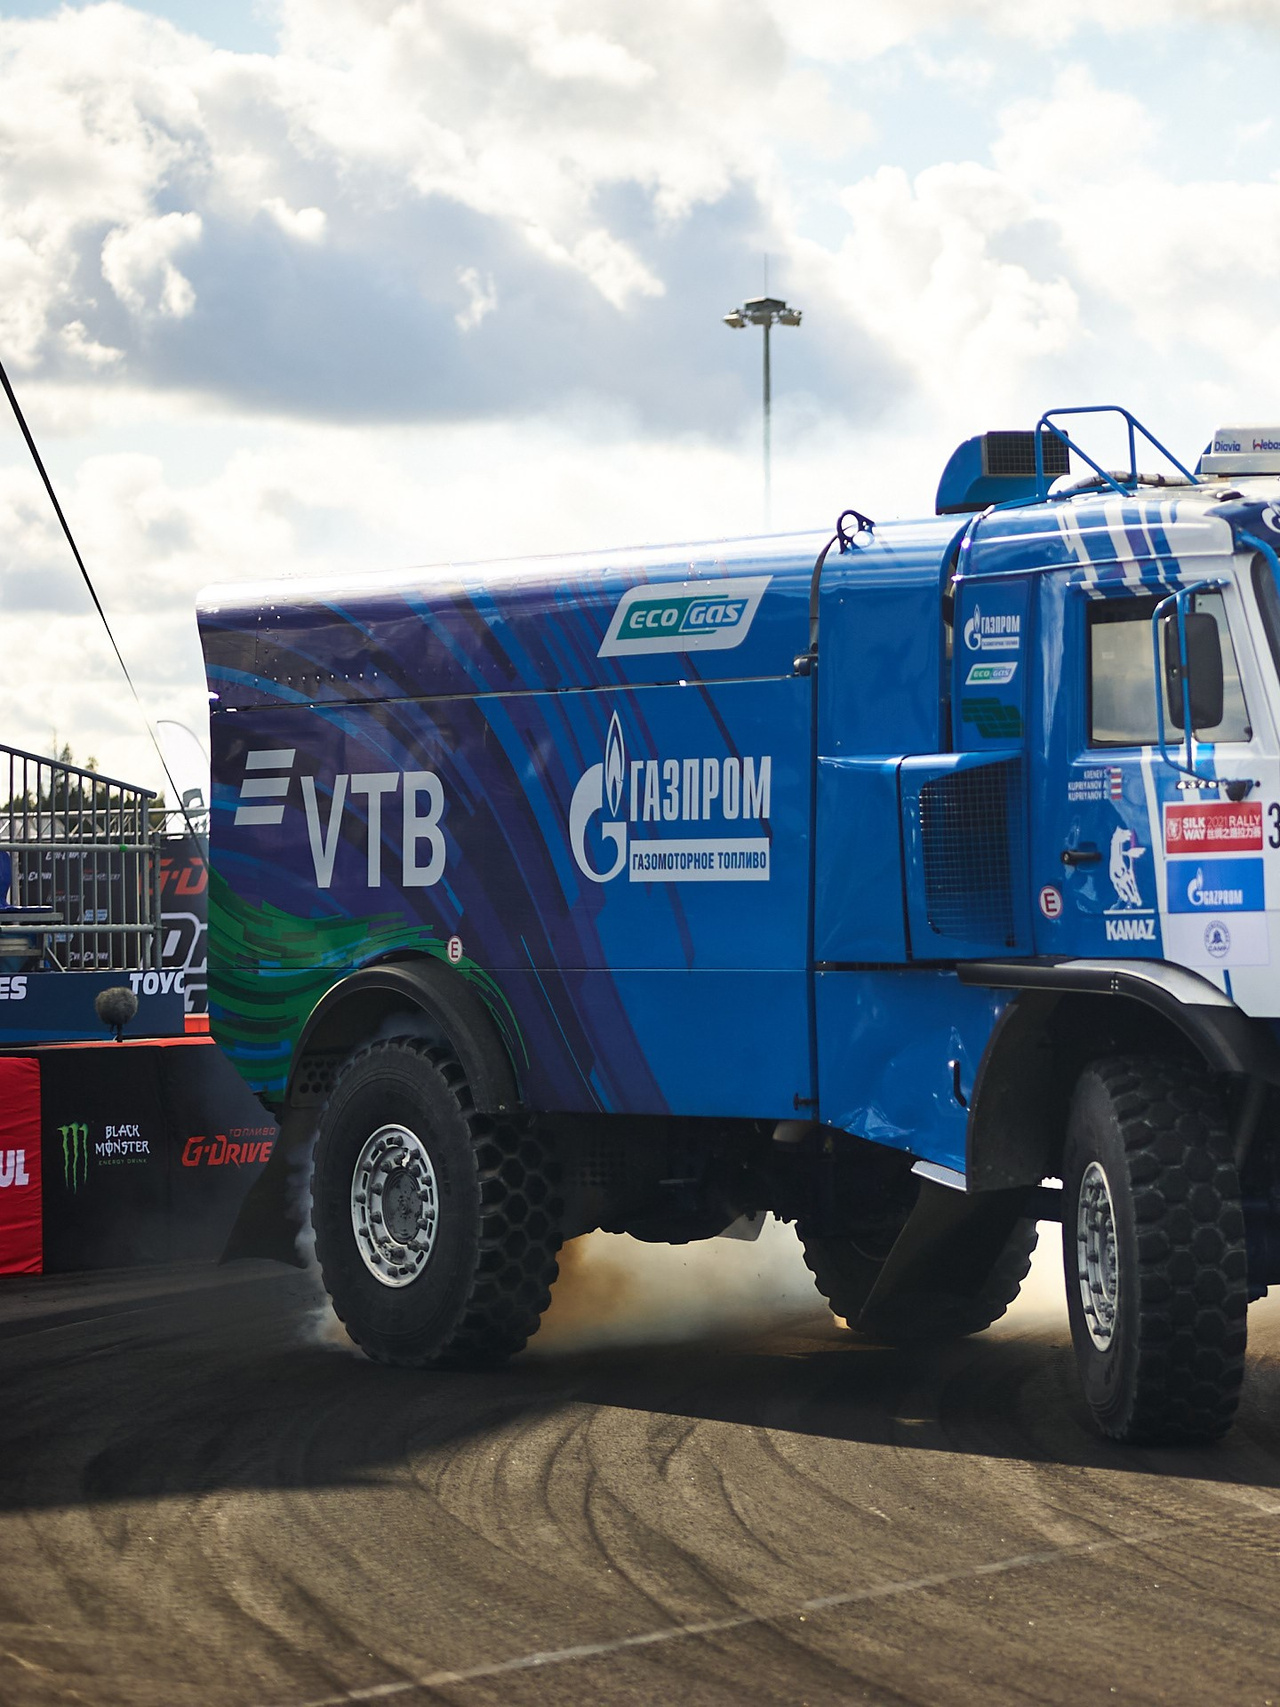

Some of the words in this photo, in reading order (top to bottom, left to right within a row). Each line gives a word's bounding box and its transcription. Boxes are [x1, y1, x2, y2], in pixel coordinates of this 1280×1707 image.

[1214, 440, 1241, 452] Diavia
[981, 615, 1020, 634] ГАЗПРОМ
[629, 756, 772, 822] ГАЗПРОМ
[300, 769, 447, 890] VTB
[1183, 817, 1206, 829] SILK
[1206, 815, 1228, 828] 2021
[1228, 814, 1261, 827] RALLY
[1183, 828, 1206, 841] WAY
[632, 853, 715, 871] ГАЗОМОТОРНОЕ
[717, 851, 767, 870] ТОПЛИВО
[1043, 892, 1058, 913] E
[1203, 889, 1243, 906] GAZPROM
[1105, 919, 1157, 941] KAMAZ
[450, 942, 460, 959] E
[105, 1124, 141, 1140] BLACK
[95, 1138, 151, 1158] MONSTER
[99, 1158, 125, 1166] ENERGY
[126, 1157, 148, 1165] DRINK
